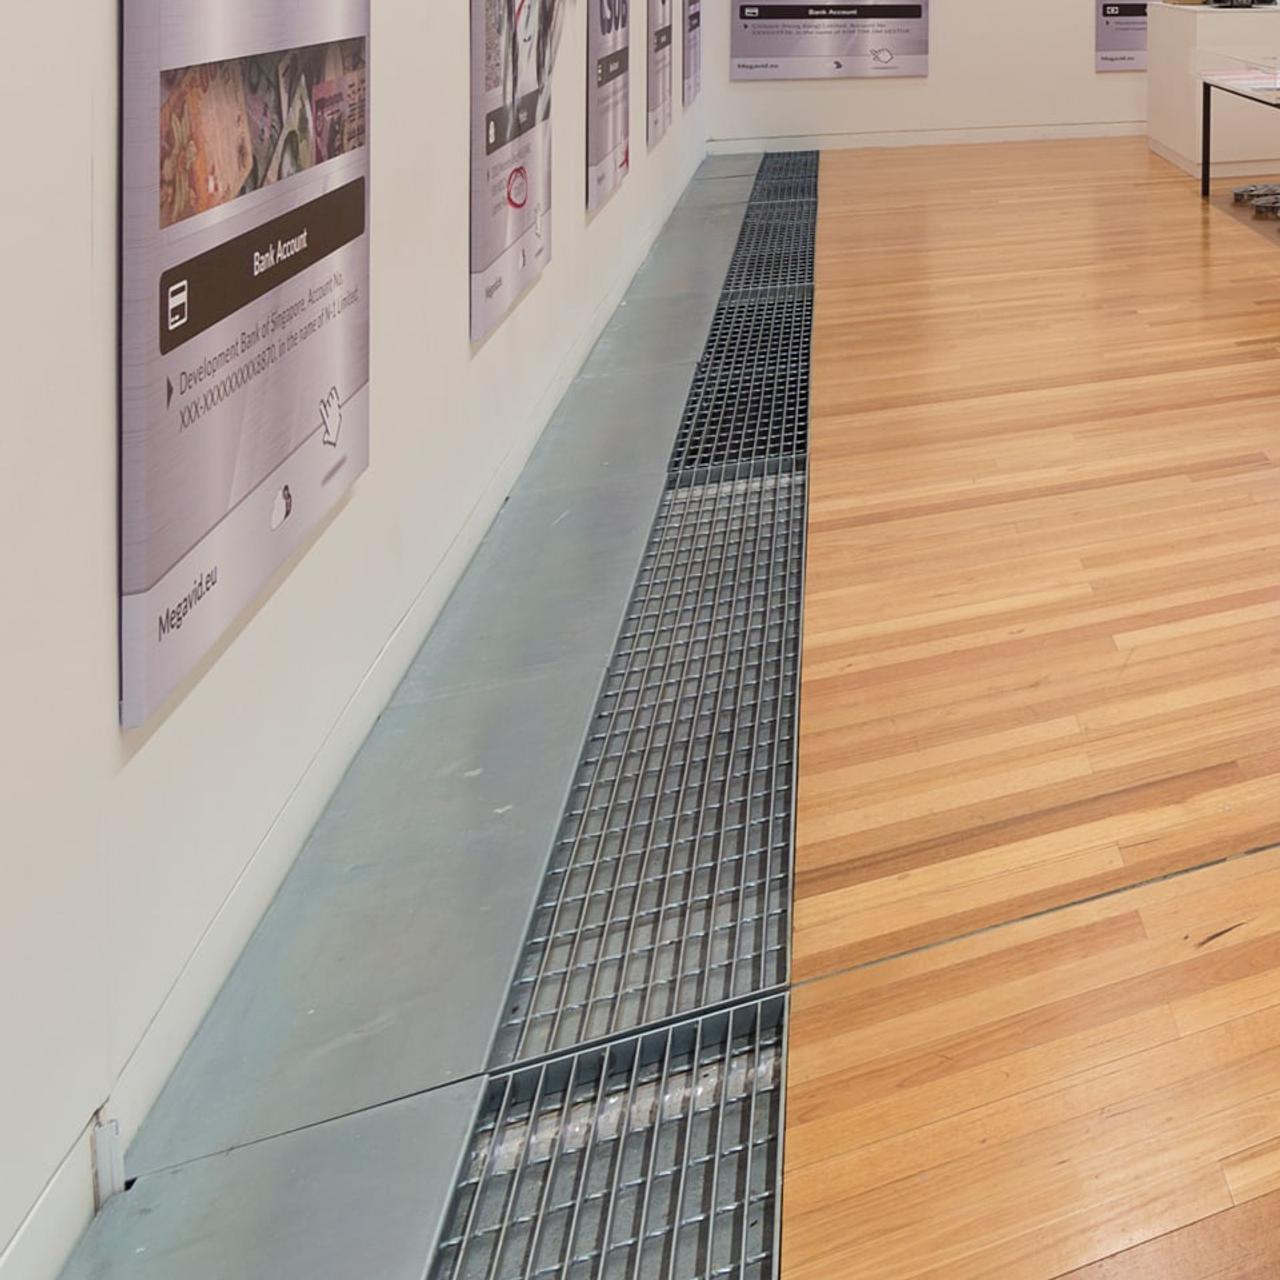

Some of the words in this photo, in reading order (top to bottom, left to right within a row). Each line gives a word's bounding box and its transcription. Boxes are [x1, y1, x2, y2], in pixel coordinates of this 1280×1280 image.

[254, 247, 274, 277] Bank
[276, 227, 308, 268] Account
[179, 341, 239, 395] Development
[240, 327, 260, 354] Bank
[261, 315, 270, 338] of
[158, 563, 218, 644] Megavid.eu
